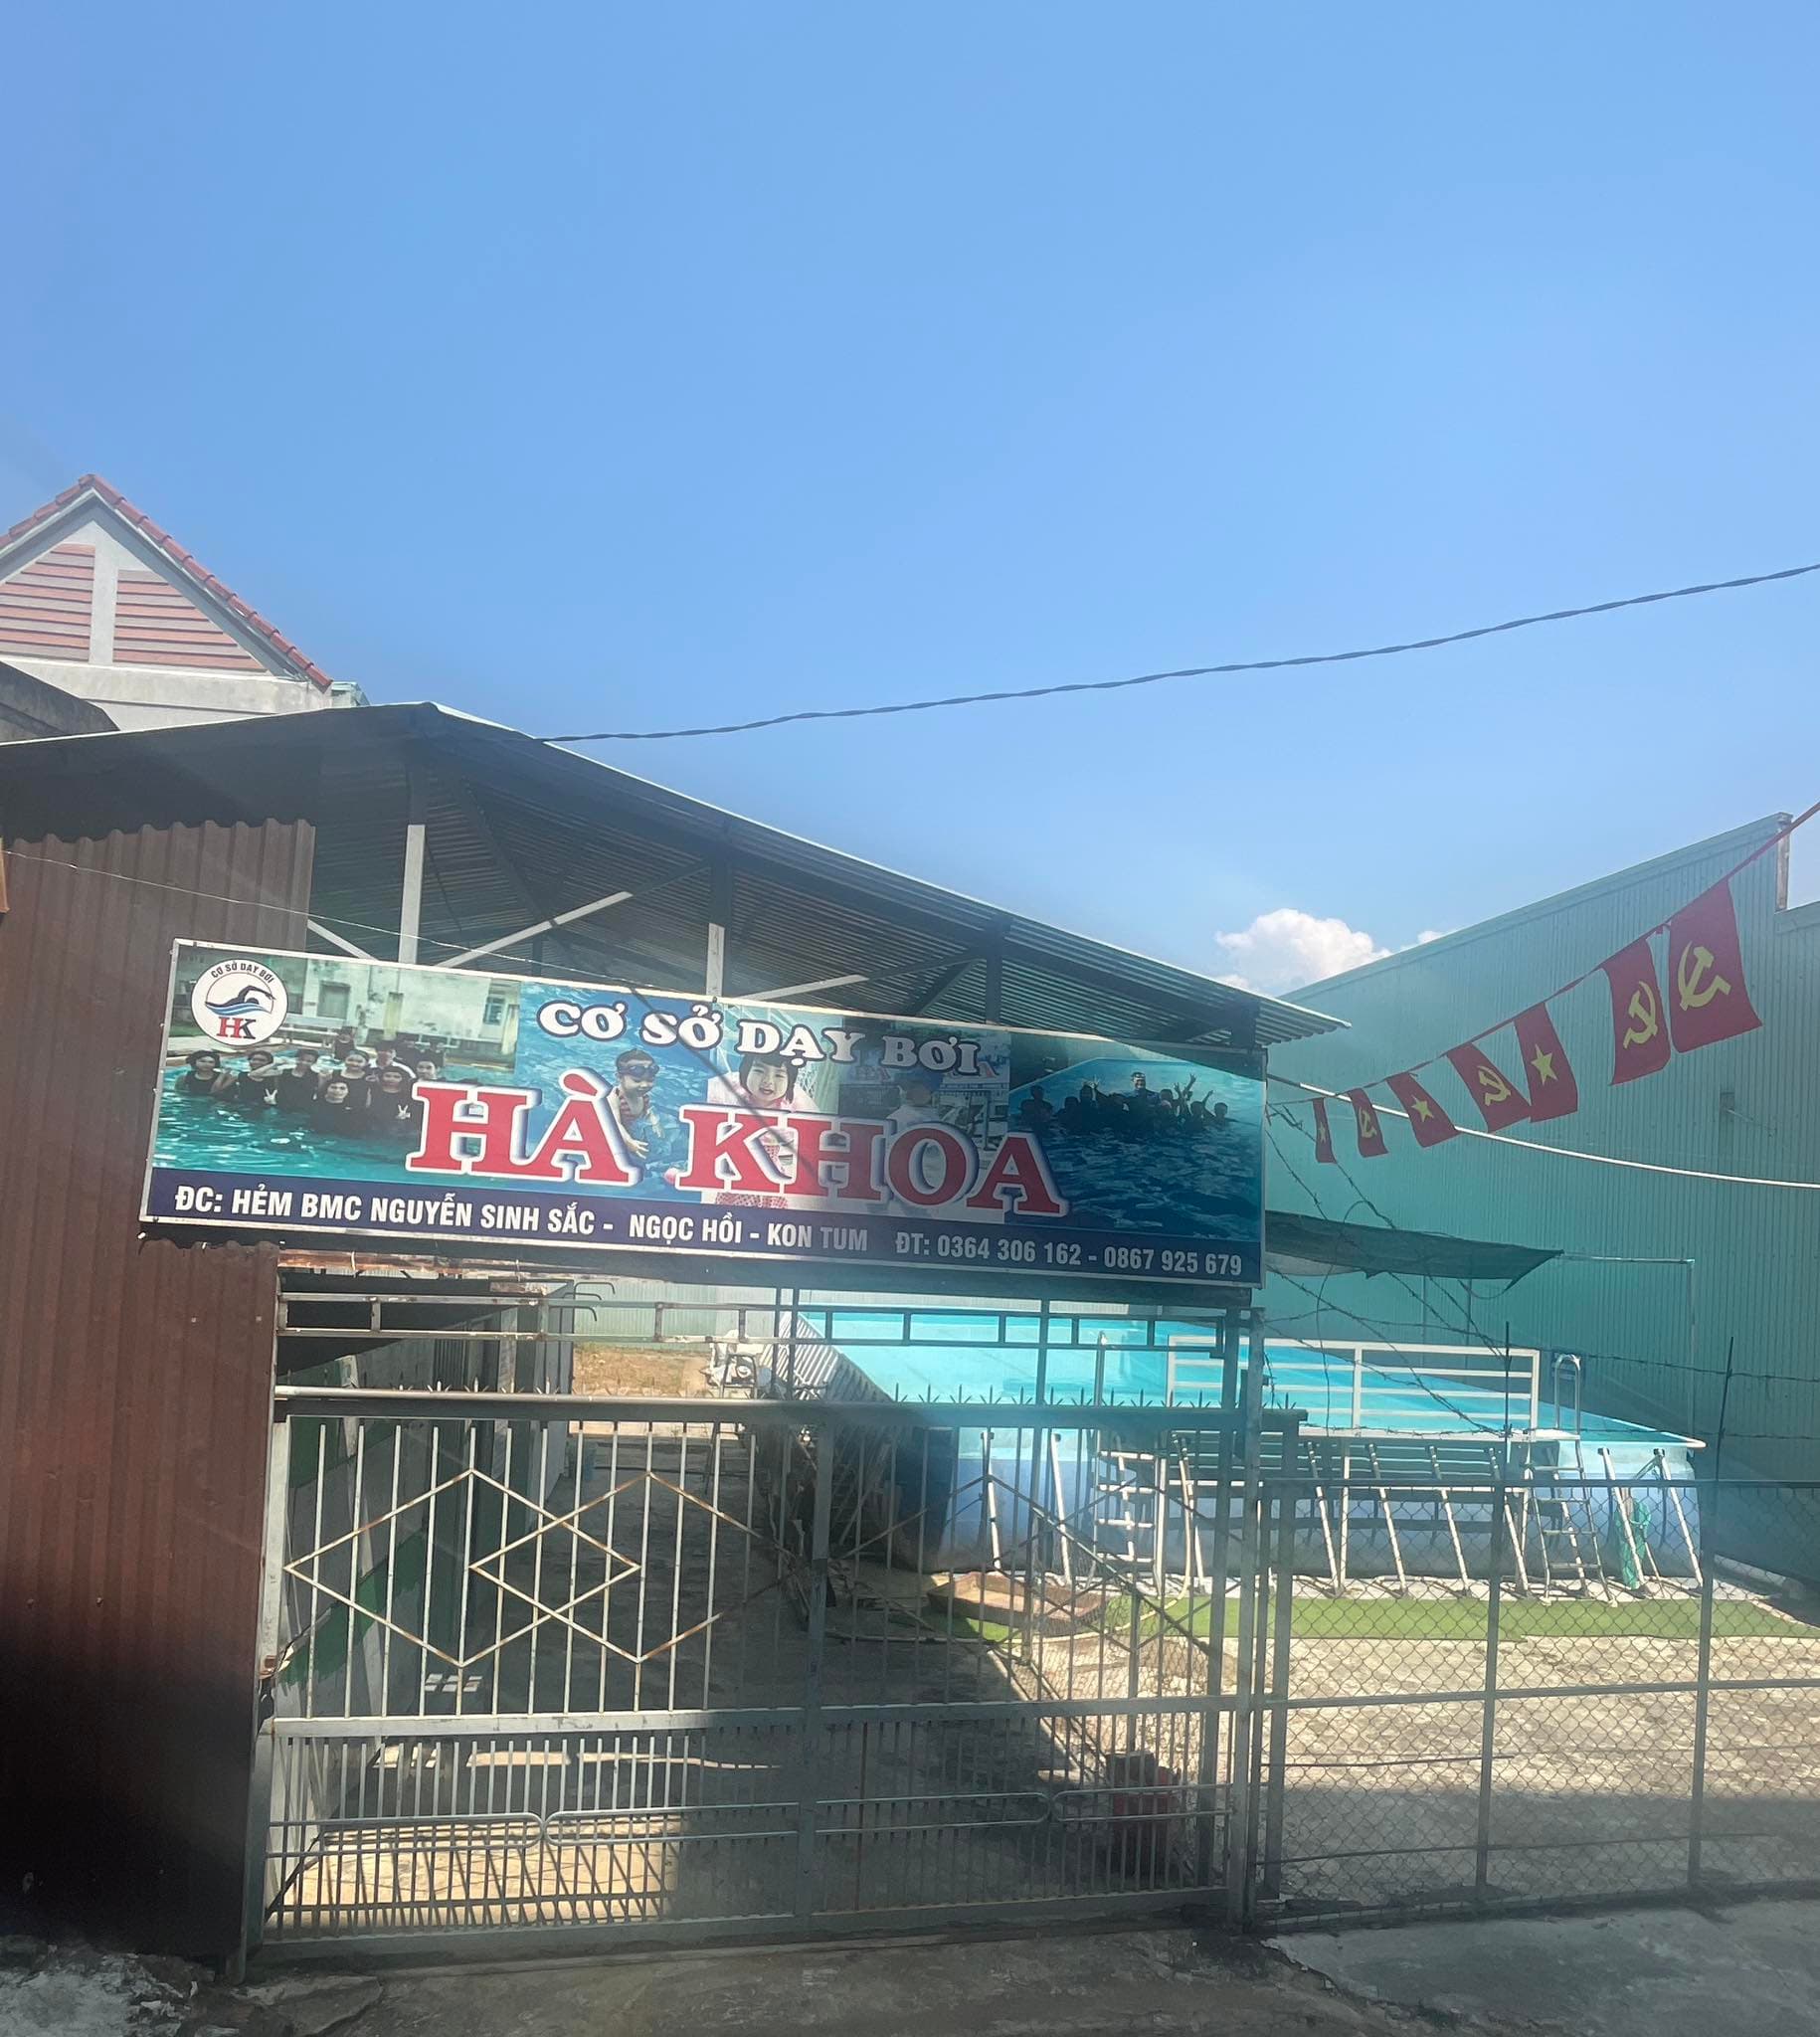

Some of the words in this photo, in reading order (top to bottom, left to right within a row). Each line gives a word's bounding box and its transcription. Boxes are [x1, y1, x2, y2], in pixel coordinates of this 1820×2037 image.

[216, 1016, 257, 1040] HK
[538, 1001, 627, 1041] CƠ
[640, 995, 723, 1050] SỞ
[736, 1020, 866, 1066] DẠY
[880, 1035, 979, 1073] BƠI
[408, 1070, 636, 1185] HÀ
[674, 1108, 1064, 1215] KHOA
[174, 1185, 224, 1212] ĐC:
[231, 1183, 293, 1216] HẺM
[300, 1193, 362, 1221] BMC
[370, 1193, 473, 1227] NGUYỄN
[480, 1204, 540, 1231] SINH
[547, 1202, 596, 1235] SẮC
[629, 1213, 694, 1245] NGỌC
[701, 1211, 743, 1243] HỒI
[767, 1222, 813, 1248] KON
[819, 1226, 868, 1251] TUM
[895, 1231, 931, 1255] ĐT:
[937, 1235, 991, 1259] 0364
[998, 1238, 1036, 1262] 306
[1044, 1242, 1082, 1265] 162
[1104, 1246, 1155, 1270] 0867
[1162, 1249, 1198, 1273] 925
[1205, 1253, 1243, 1276] 679
